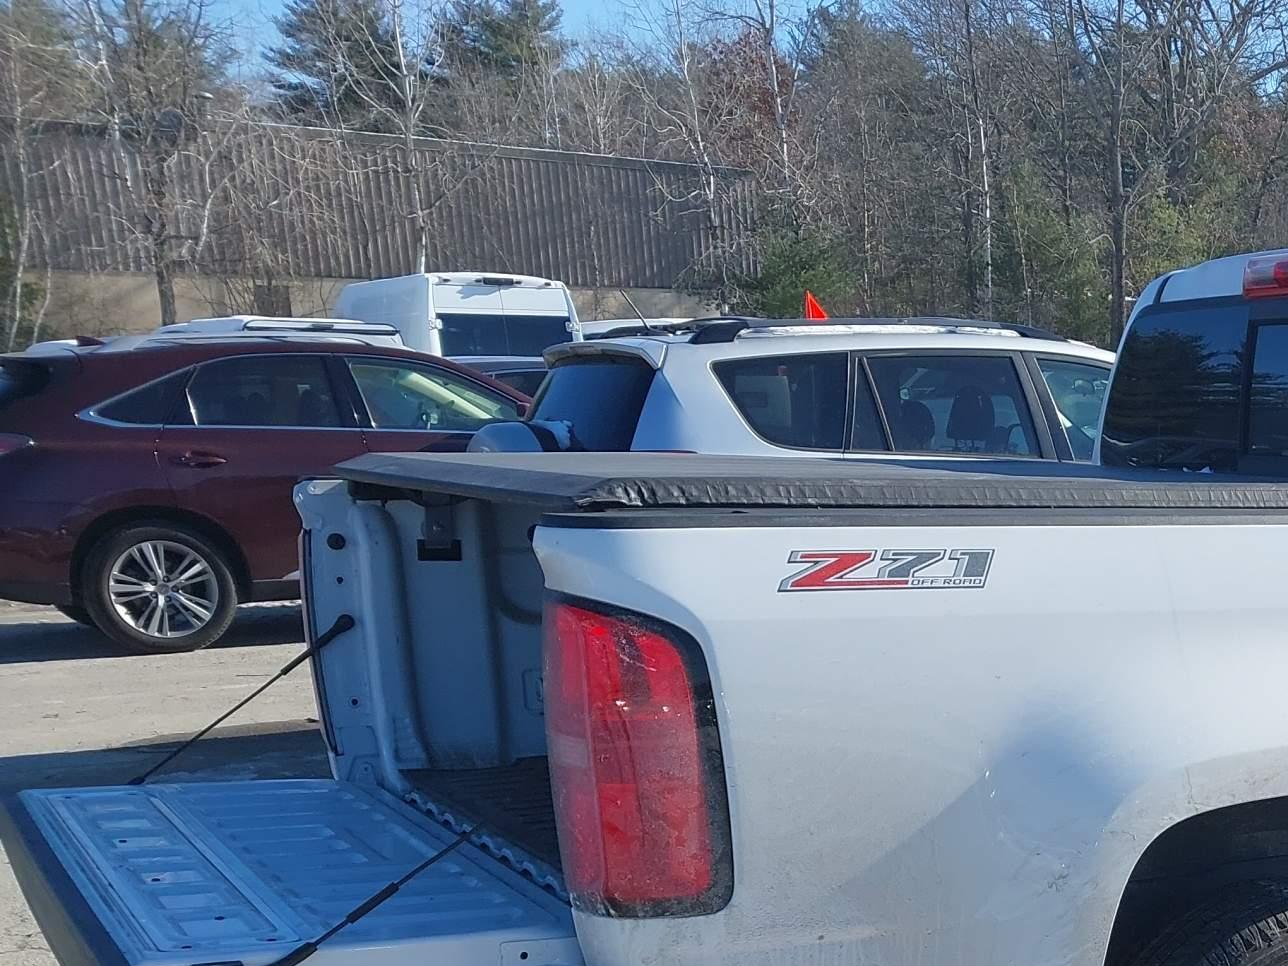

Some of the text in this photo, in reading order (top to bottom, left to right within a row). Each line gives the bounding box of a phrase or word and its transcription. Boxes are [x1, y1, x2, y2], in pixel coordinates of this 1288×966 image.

[777, 549, 995, 592] Z71
[911, 578, 983, 586] OFF ROAD
